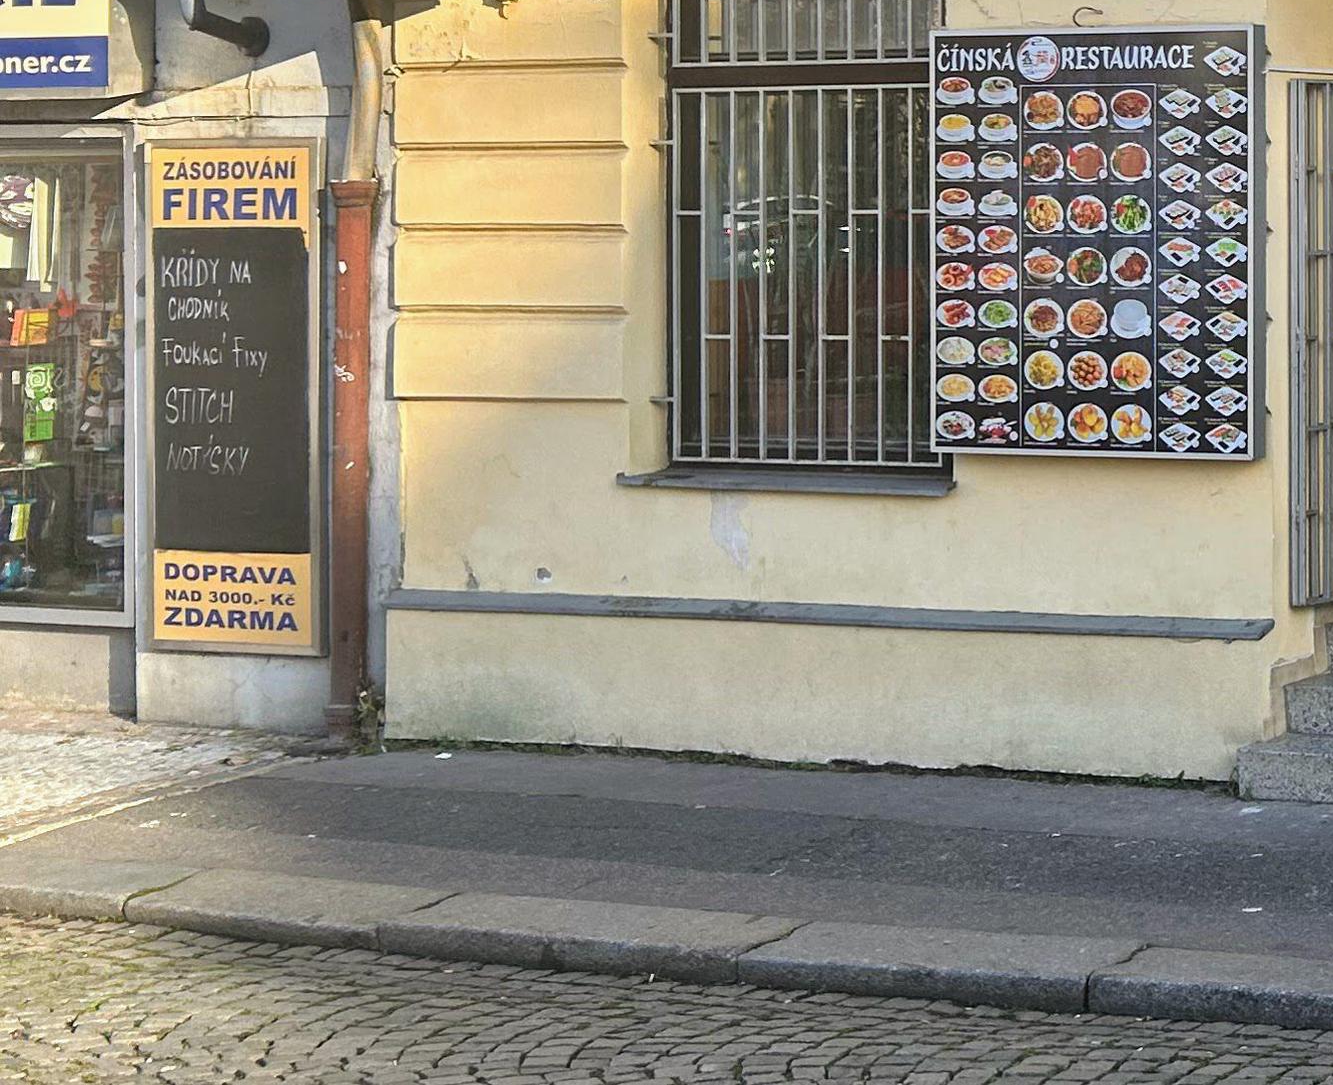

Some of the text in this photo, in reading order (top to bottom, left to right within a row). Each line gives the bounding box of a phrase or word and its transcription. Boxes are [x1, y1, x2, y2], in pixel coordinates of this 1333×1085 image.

[936, 42, 1015, 73] ČÍNSKÁ
[1060, 44, 1195, 71] RESTAURACE
[163, 155, 297, 180] ZÁSOBOVÁNÍ
[163, 187, 297, 221] FIREM
[229, 260, 252, 284] NA
[168, 288, 230, 321] CHODNÍK
[165, 386, 234, 425] STITCH
[164, 562, 297, 586] DOPRAVA
[165, 589, 202, 603] NAD
[271, 592, 296, 606] Kč
[163, 606, 299, 632] ZDARMA
